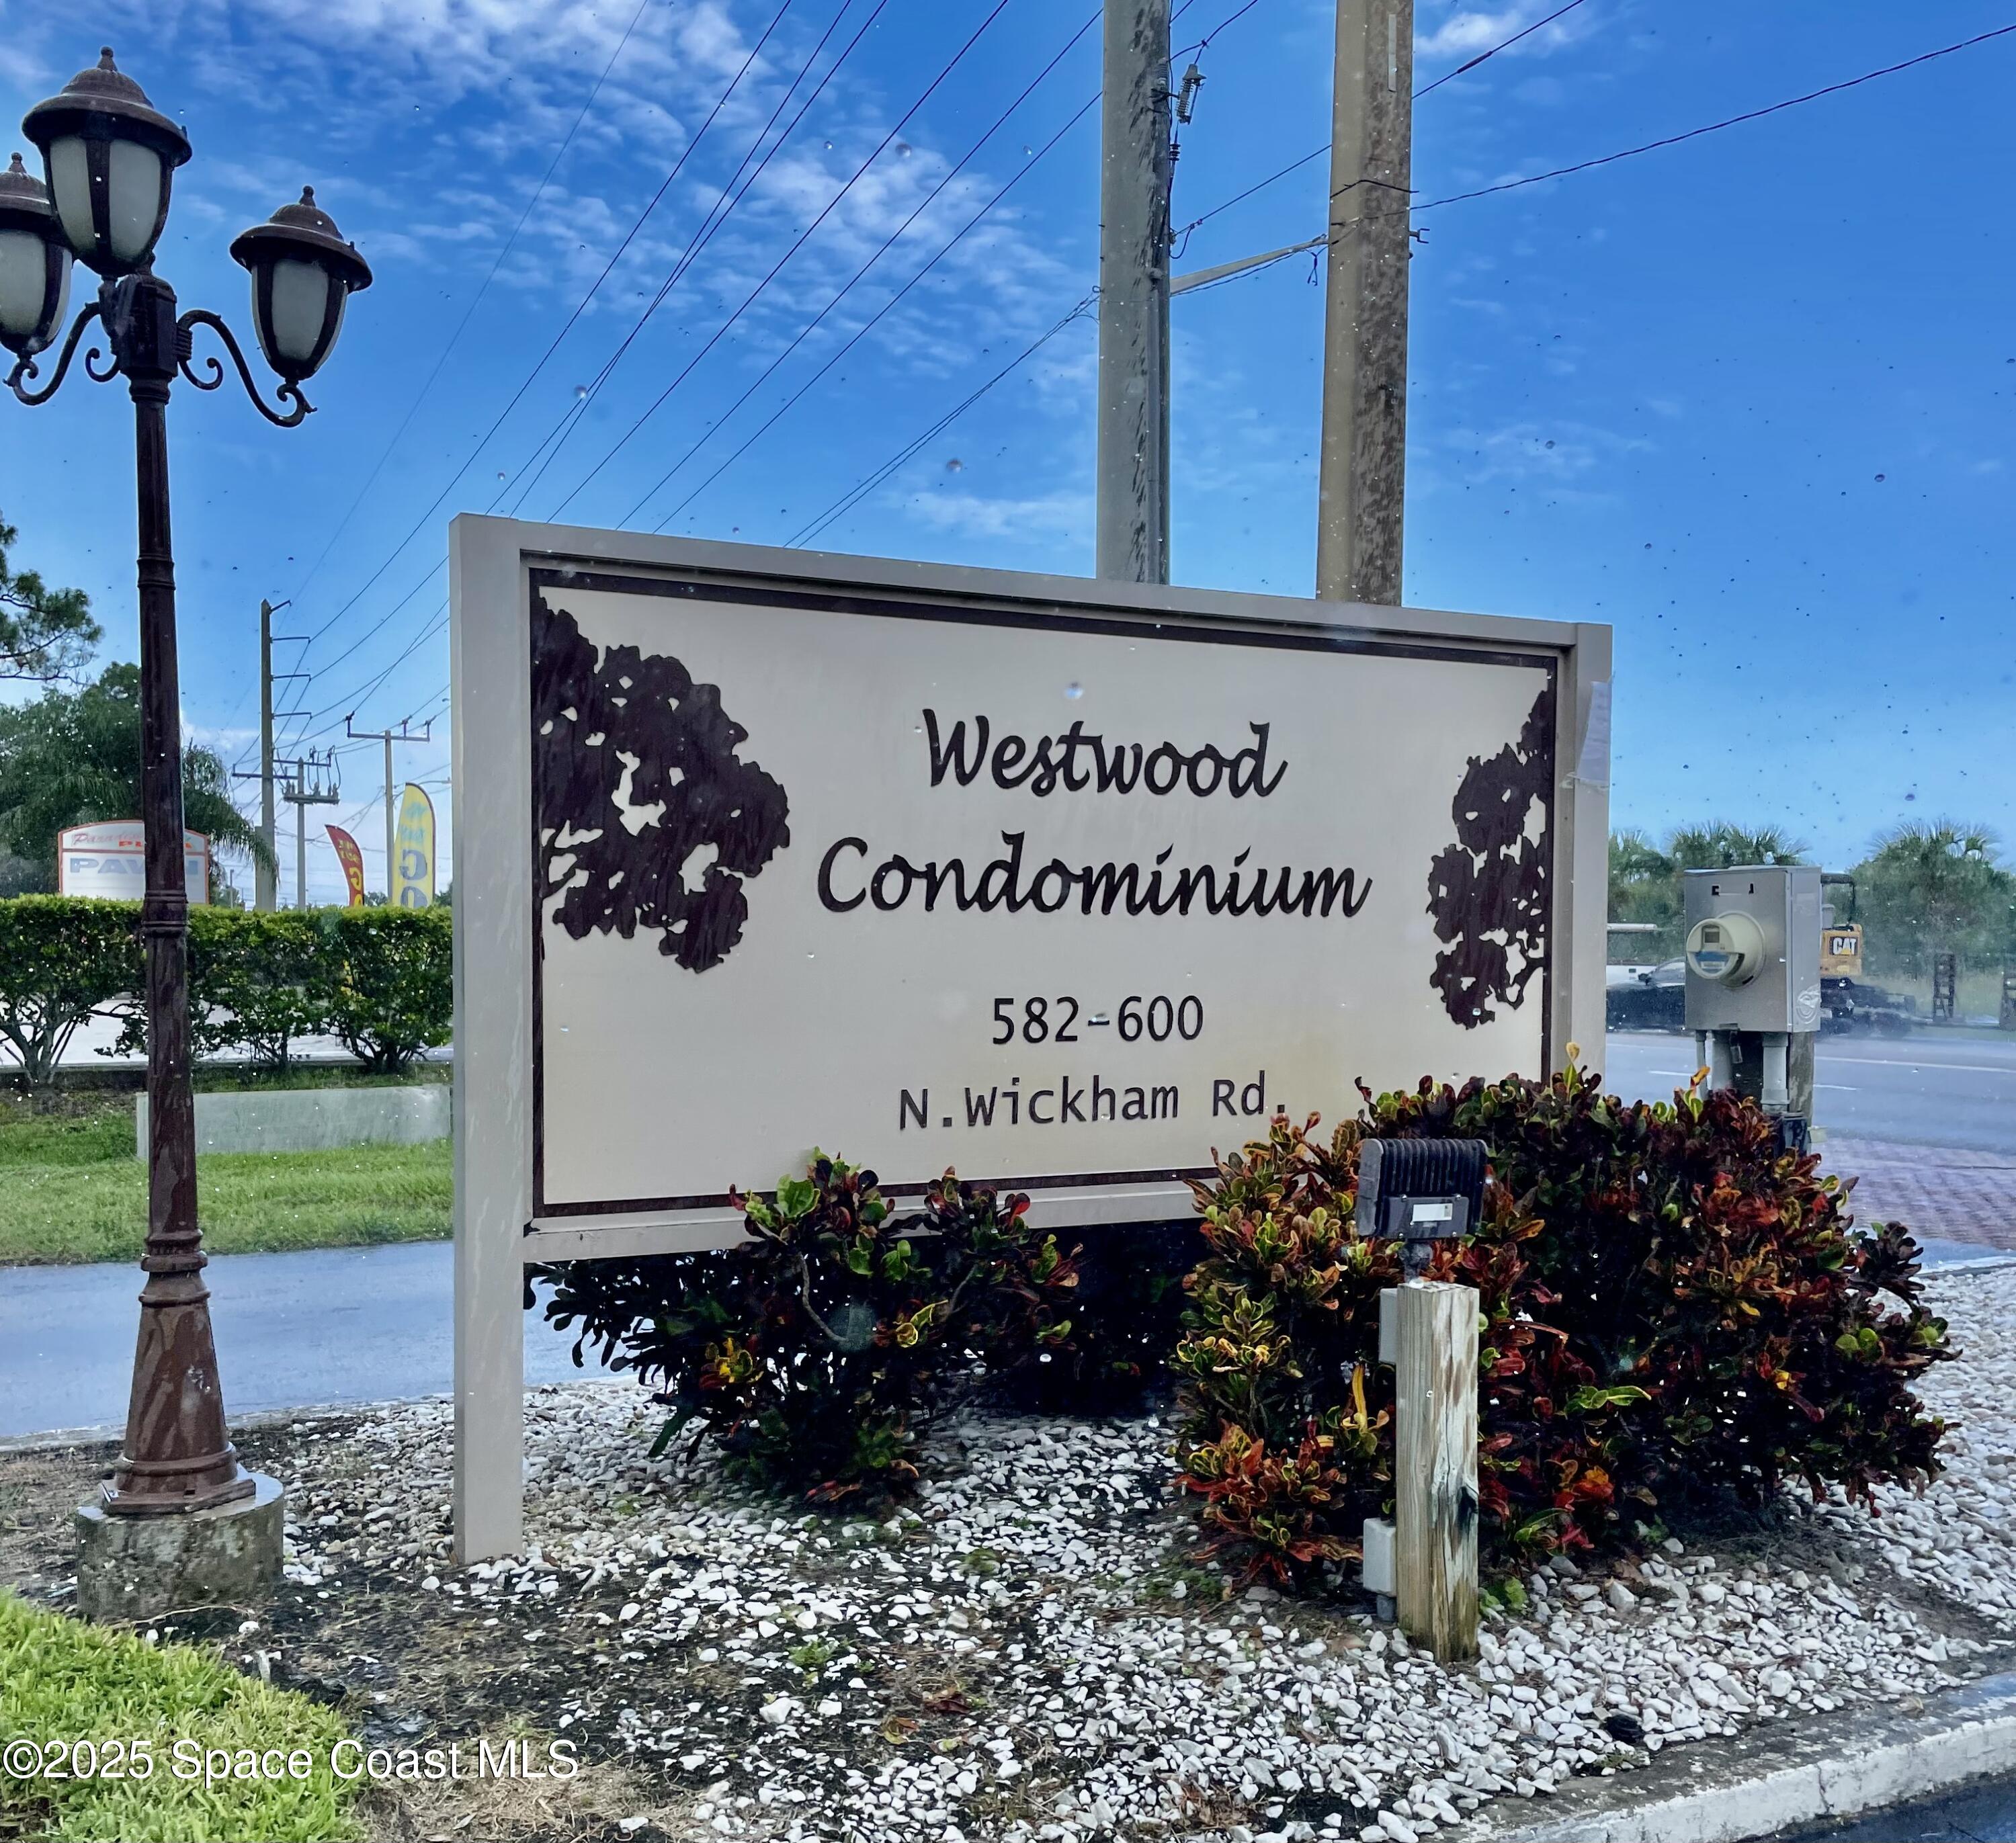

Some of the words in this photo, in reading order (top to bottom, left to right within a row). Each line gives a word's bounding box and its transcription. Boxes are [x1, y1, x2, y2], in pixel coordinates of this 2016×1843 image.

[922, 708, 1289, 799] Westwood
[816, 830, 1374, 918] Condominium
[1833, 937, 1856, 955] CAT
[992, 995, 1204, 1045] 582-600
[1212, 1070, 1286, 1117] Rd.
